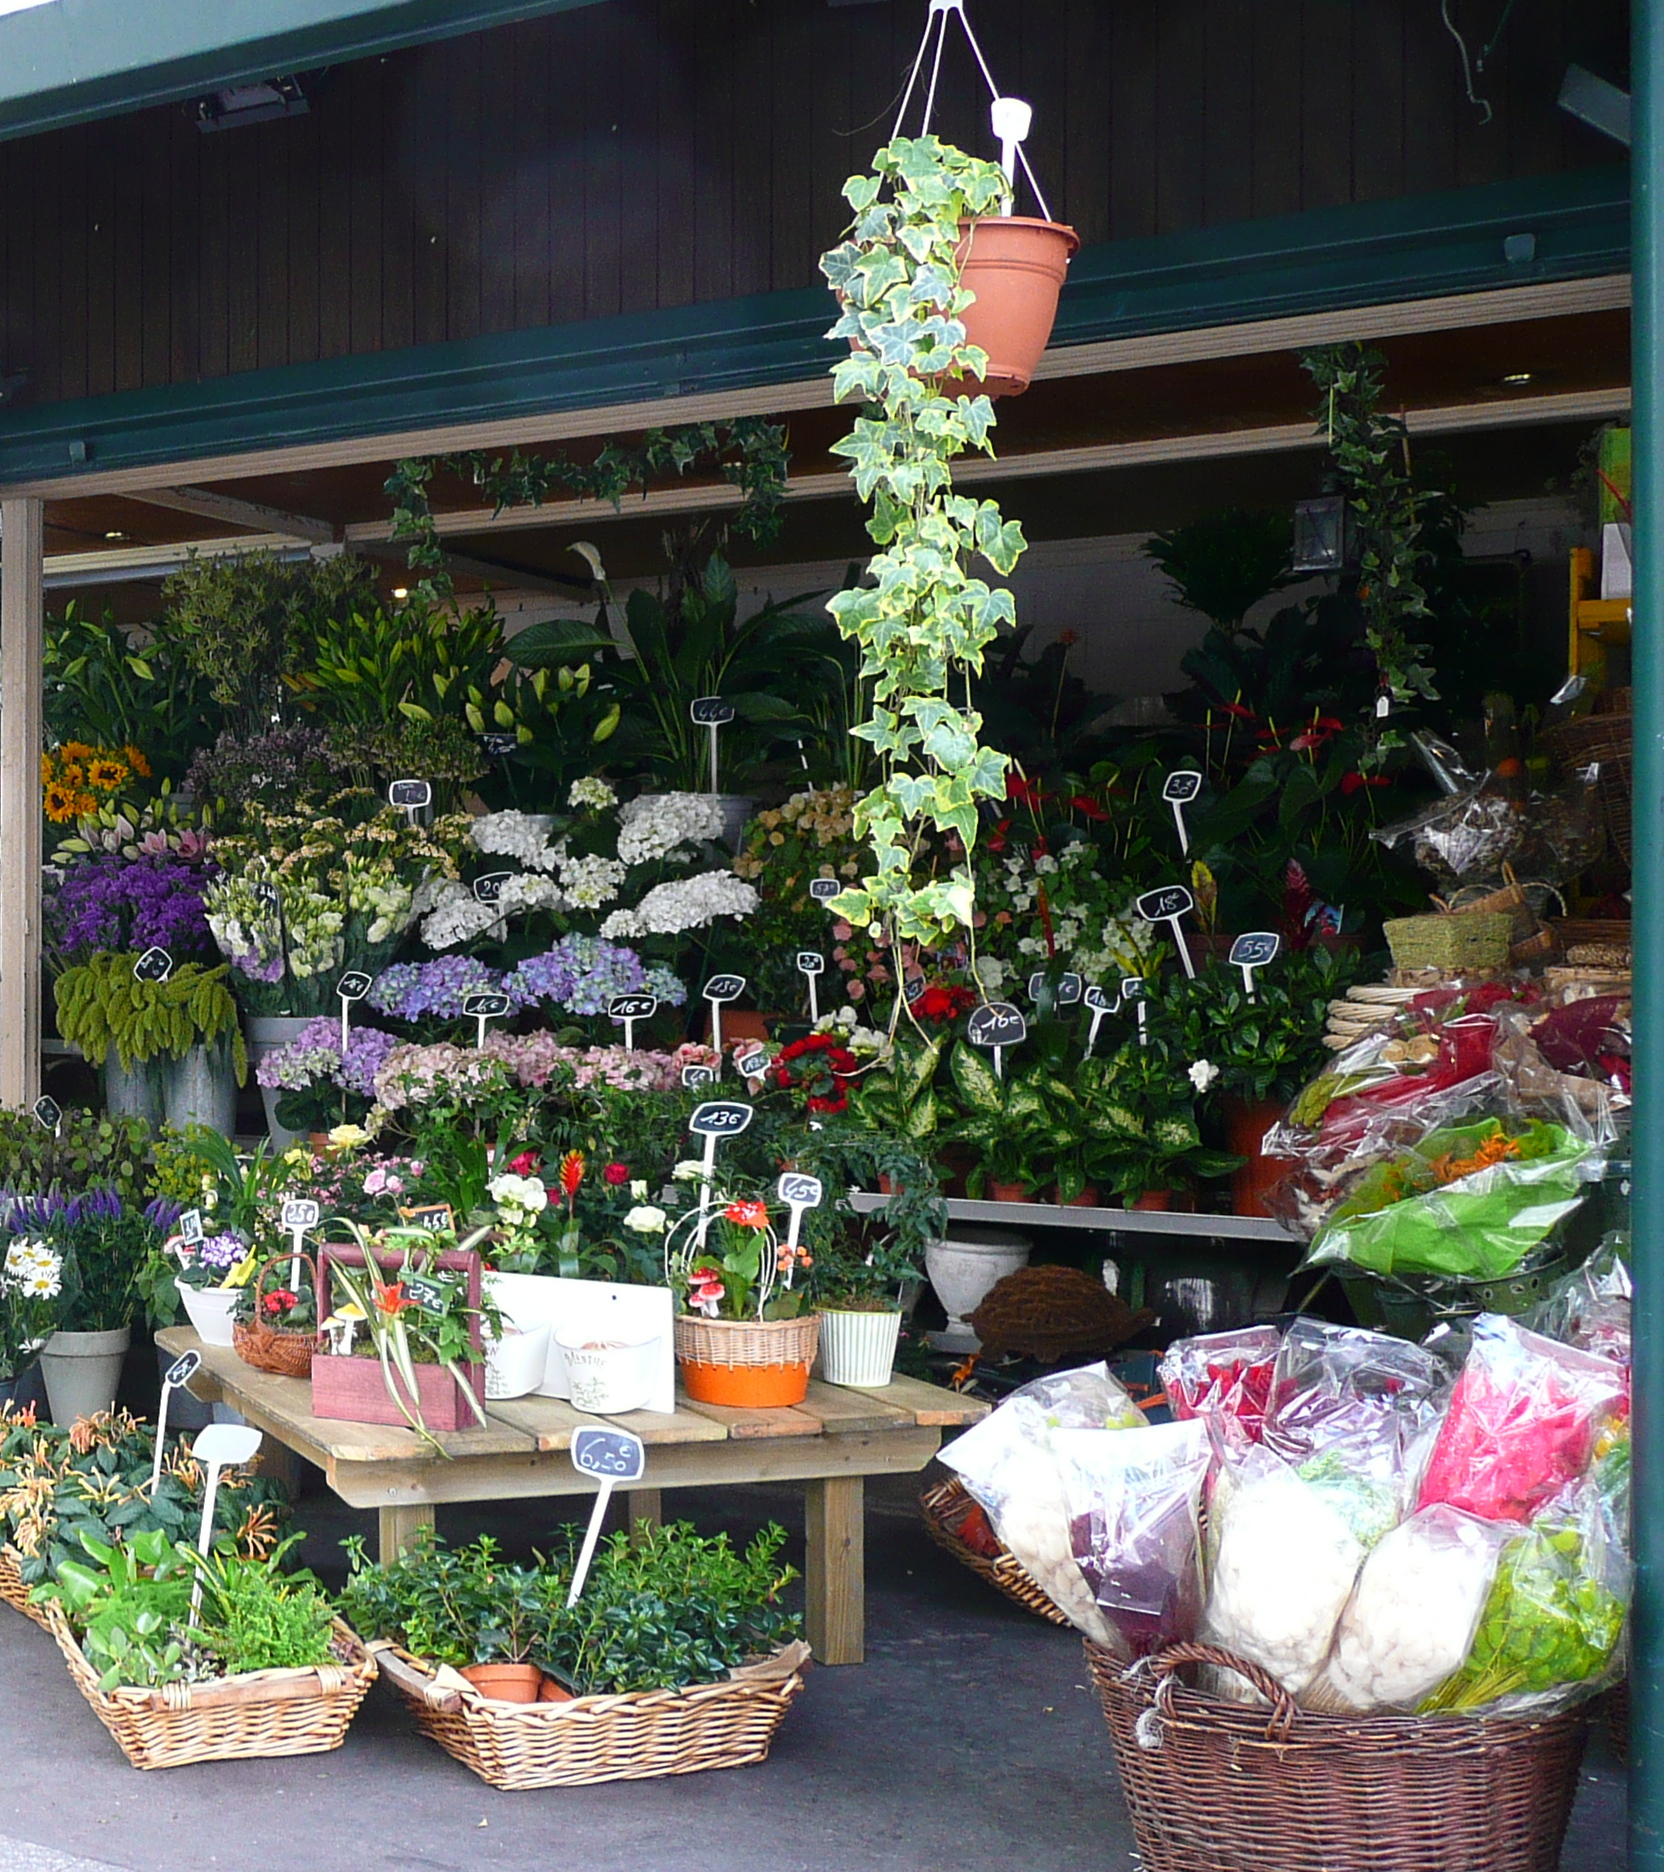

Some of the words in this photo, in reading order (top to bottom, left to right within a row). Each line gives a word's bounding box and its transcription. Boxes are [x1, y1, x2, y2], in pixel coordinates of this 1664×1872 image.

[1238, 940, 1271, 960] 55€
[610, 1000, 652, 1014] 16€
[700, 1110, 741, 1126] 13€
[786, 1178, 819, 1200] 45€
